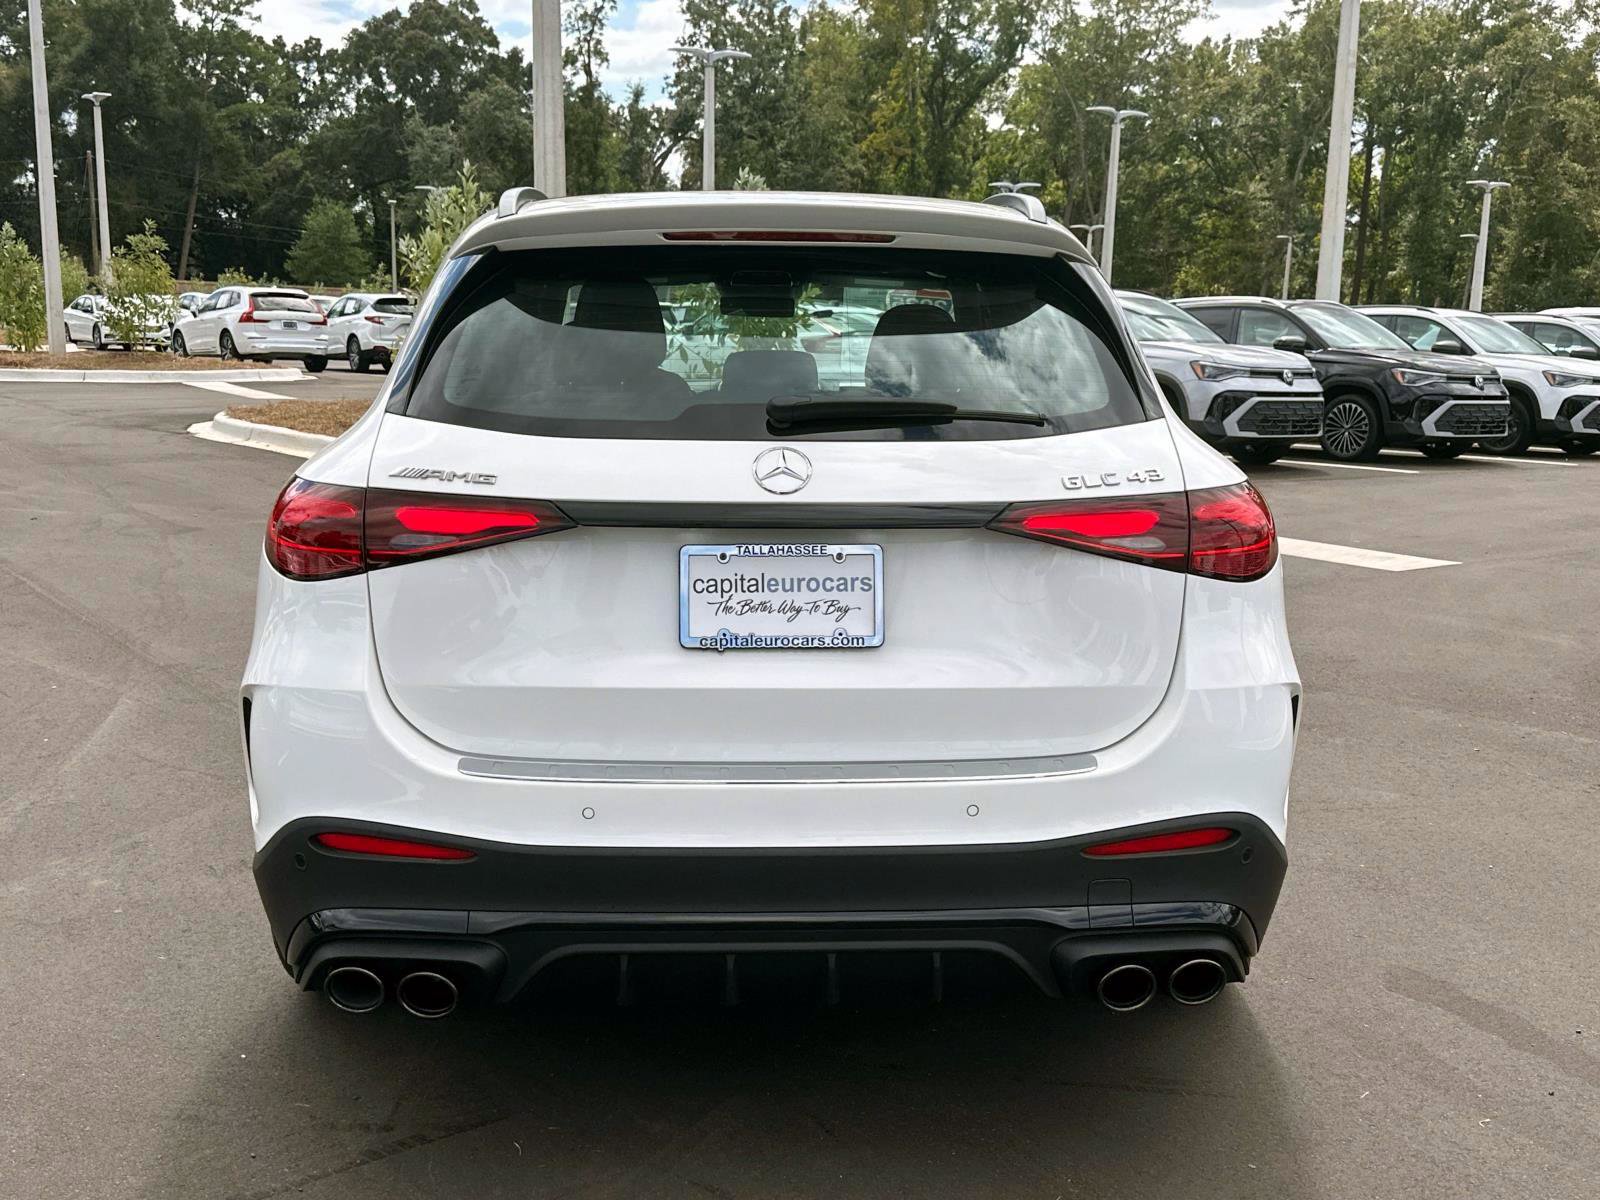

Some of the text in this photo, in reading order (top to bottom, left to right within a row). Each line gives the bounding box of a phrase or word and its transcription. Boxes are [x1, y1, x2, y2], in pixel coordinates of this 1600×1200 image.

[419, 468, 498, 486] AMG
[1061, 468, 1165, 490] GLC 43
[736, 545, 828, 555] TALLAHASSEE
[692, 572, 873, 599] capitaleurocars
[707, 594, 861, 623] The Better Way To Buy
[700, 634, 866, 651] capitaleurocars.com
